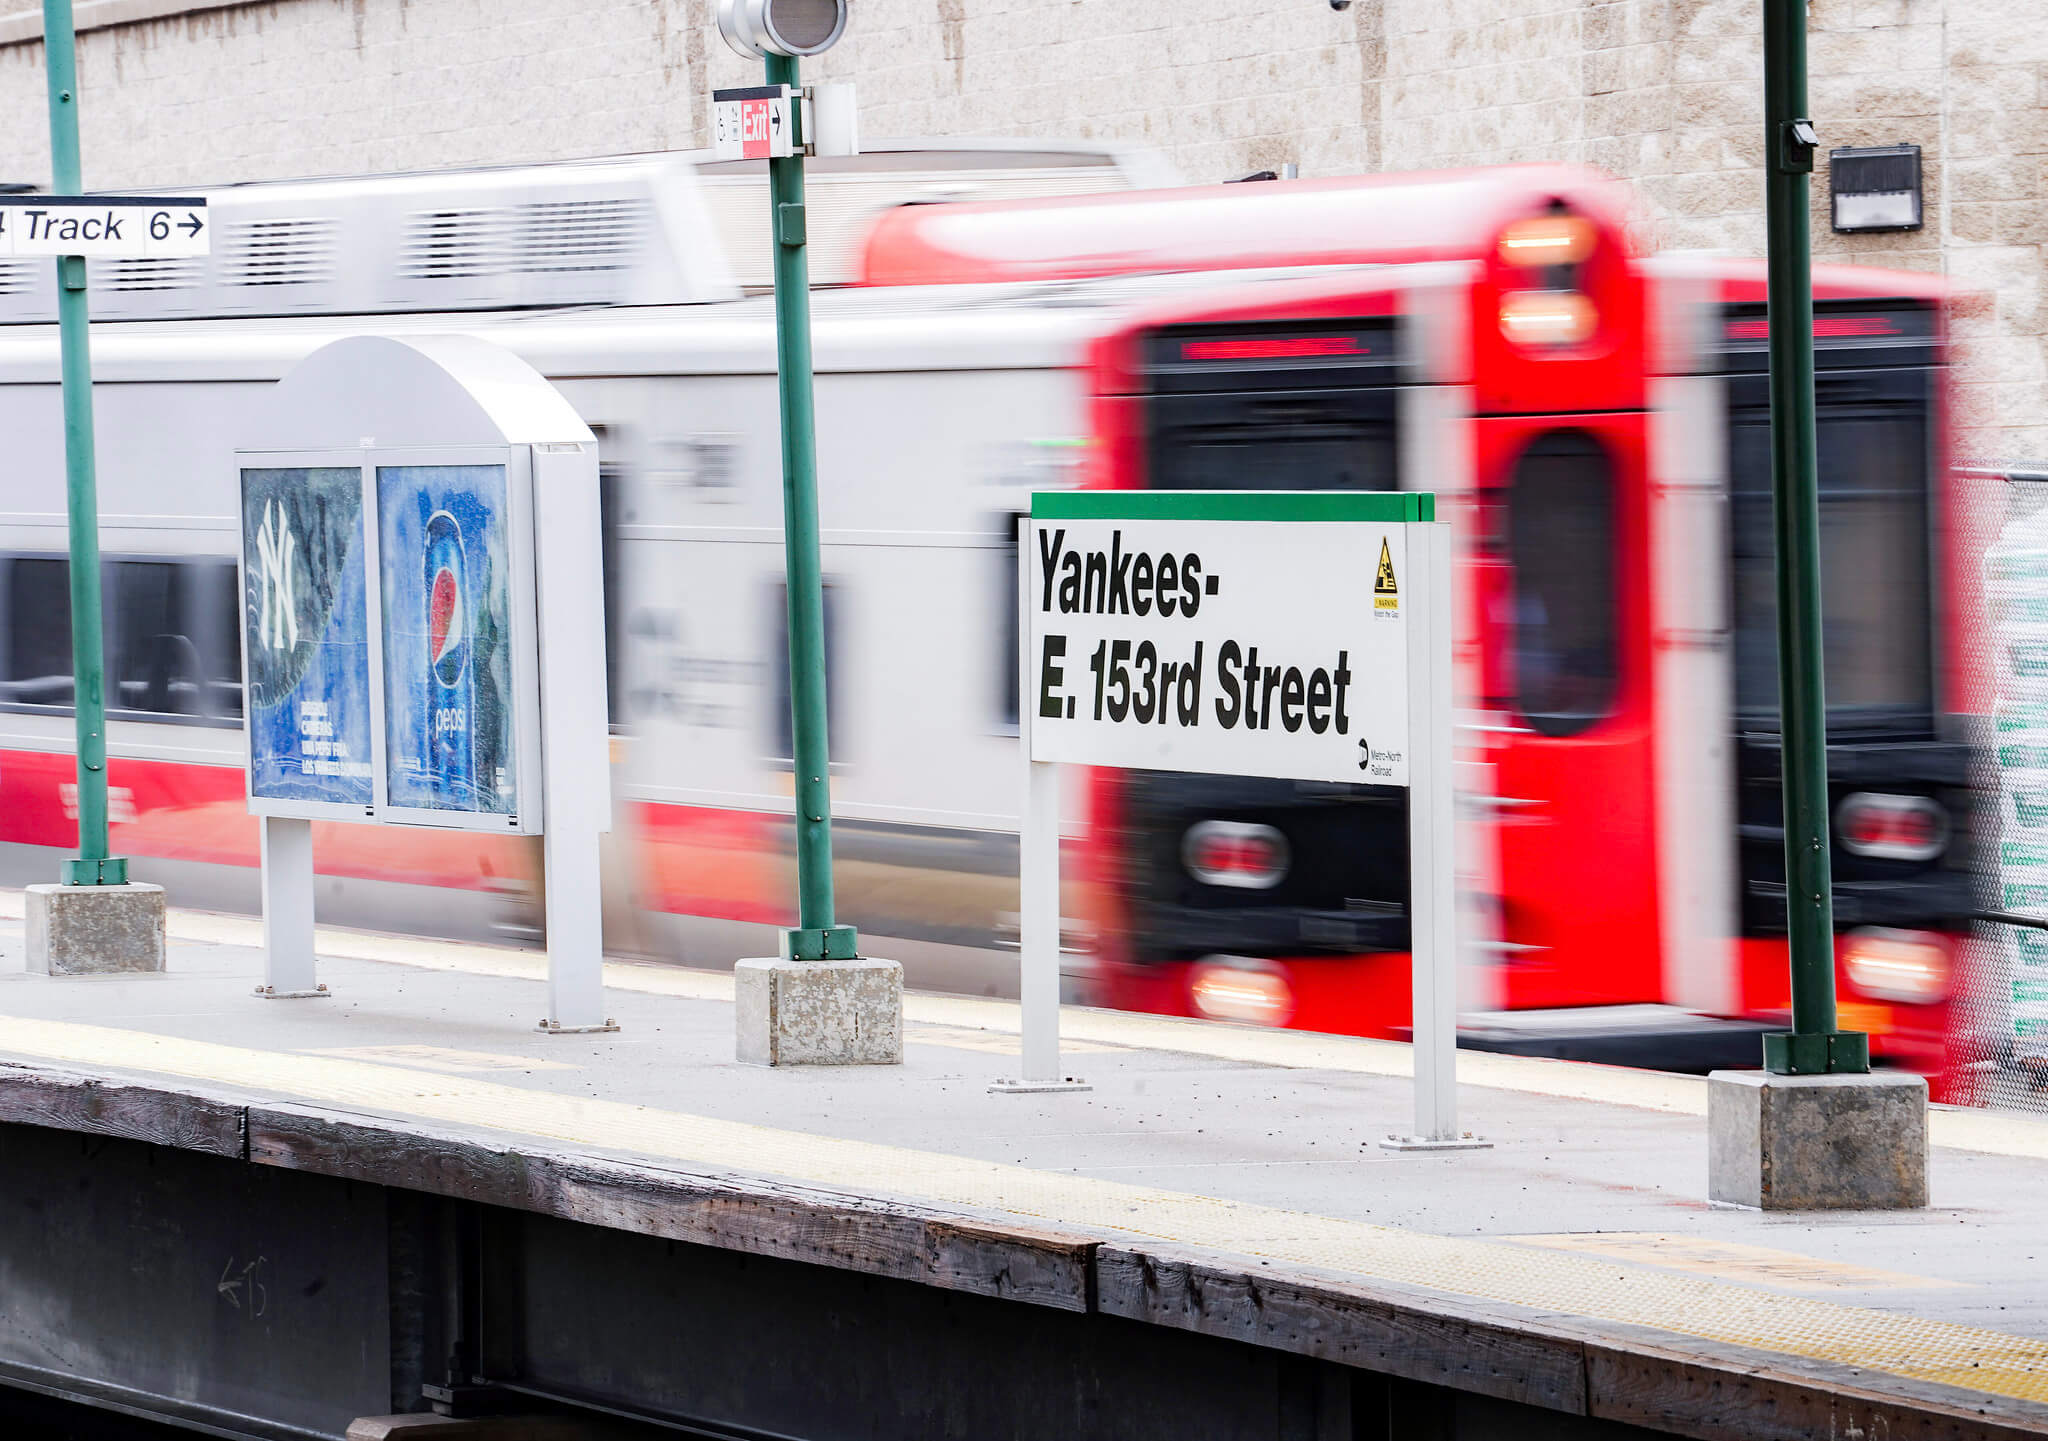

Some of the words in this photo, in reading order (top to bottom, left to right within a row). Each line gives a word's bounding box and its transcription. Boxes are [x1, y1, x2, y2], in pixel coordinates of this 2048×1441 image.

[743, 103, 768, 142] Exit
[24, 210, 125, 241] Track
[149, 211, 171, 241] 6
[1038, 528, 1220, 618] Yankees-
[1039, 634, 1077, 720] E.
[1089, 639, 1204, 728] 153rd
[1214, 639, 1352, 736] Street
[435, 703, 465, 740] pepsi
